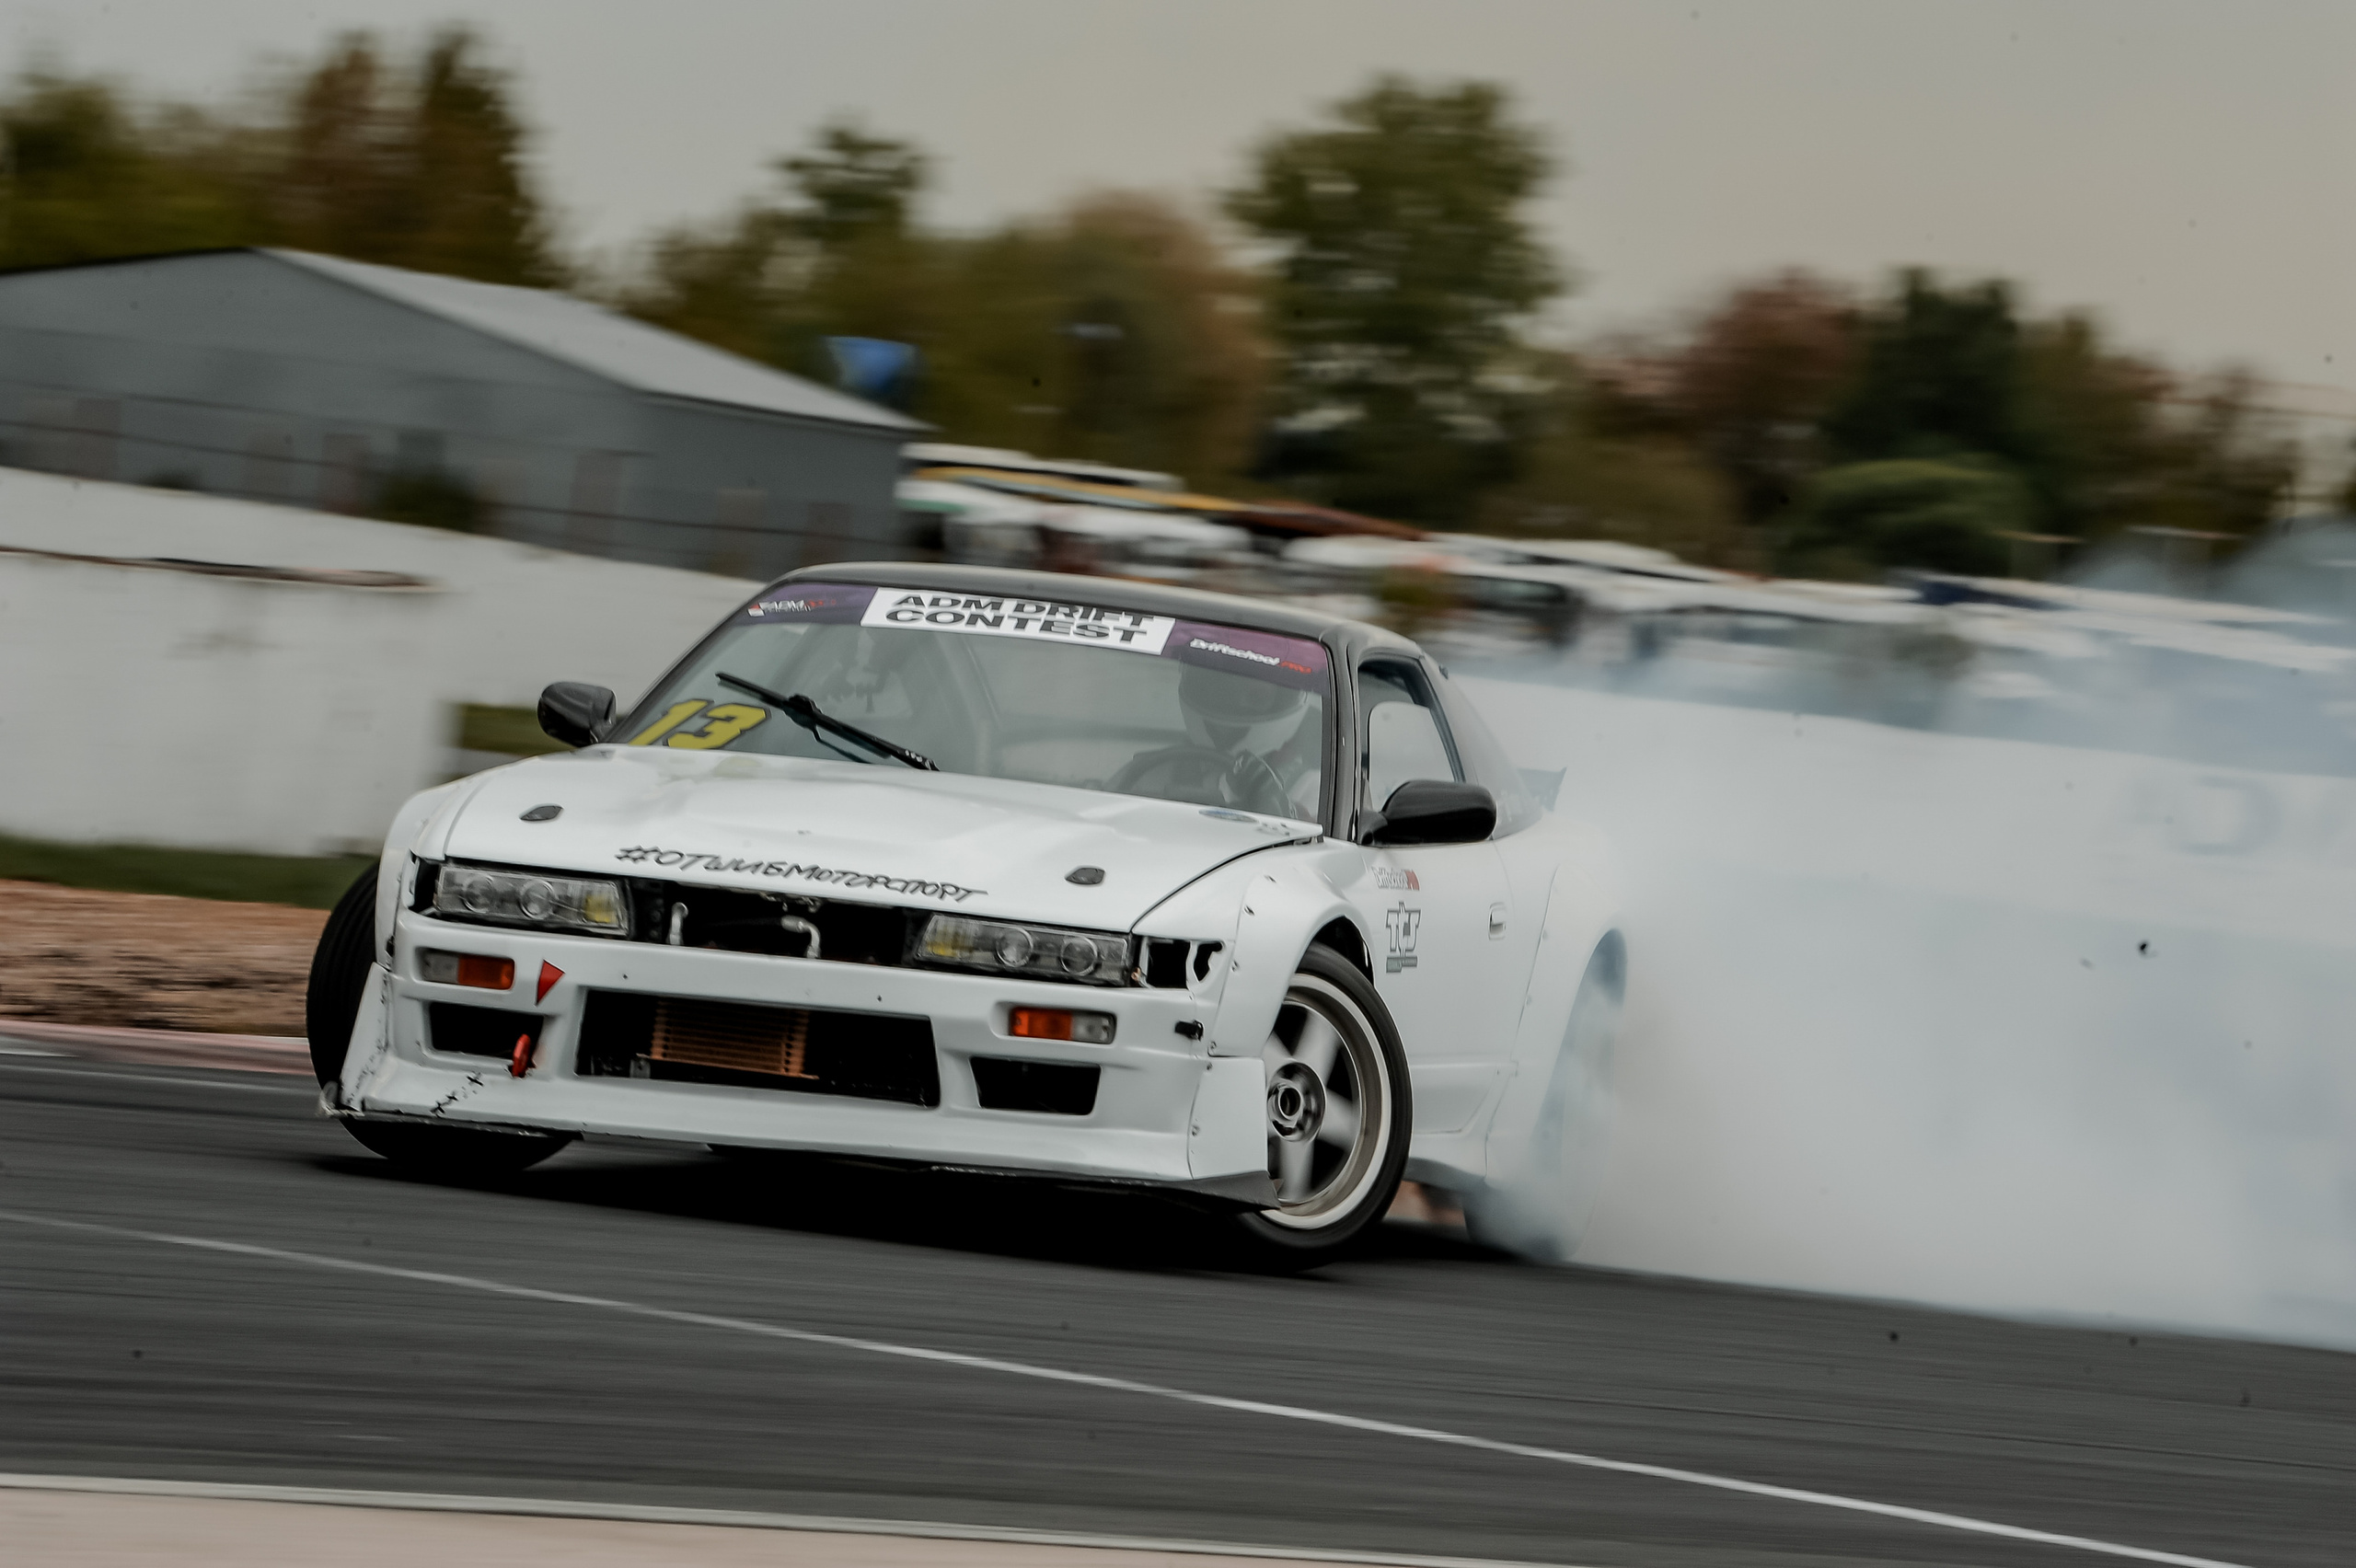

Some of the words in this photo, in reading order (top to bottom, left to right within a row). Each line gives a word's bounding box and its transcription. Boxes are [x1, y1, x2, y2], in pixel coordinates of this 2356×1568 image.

[884, 608, 1148, 642] CONTEST
[894, 594, 1005, 611] ADM
[1011, 601, 1155, 628] DRIFT
[626, 698, 772, 750] 13
